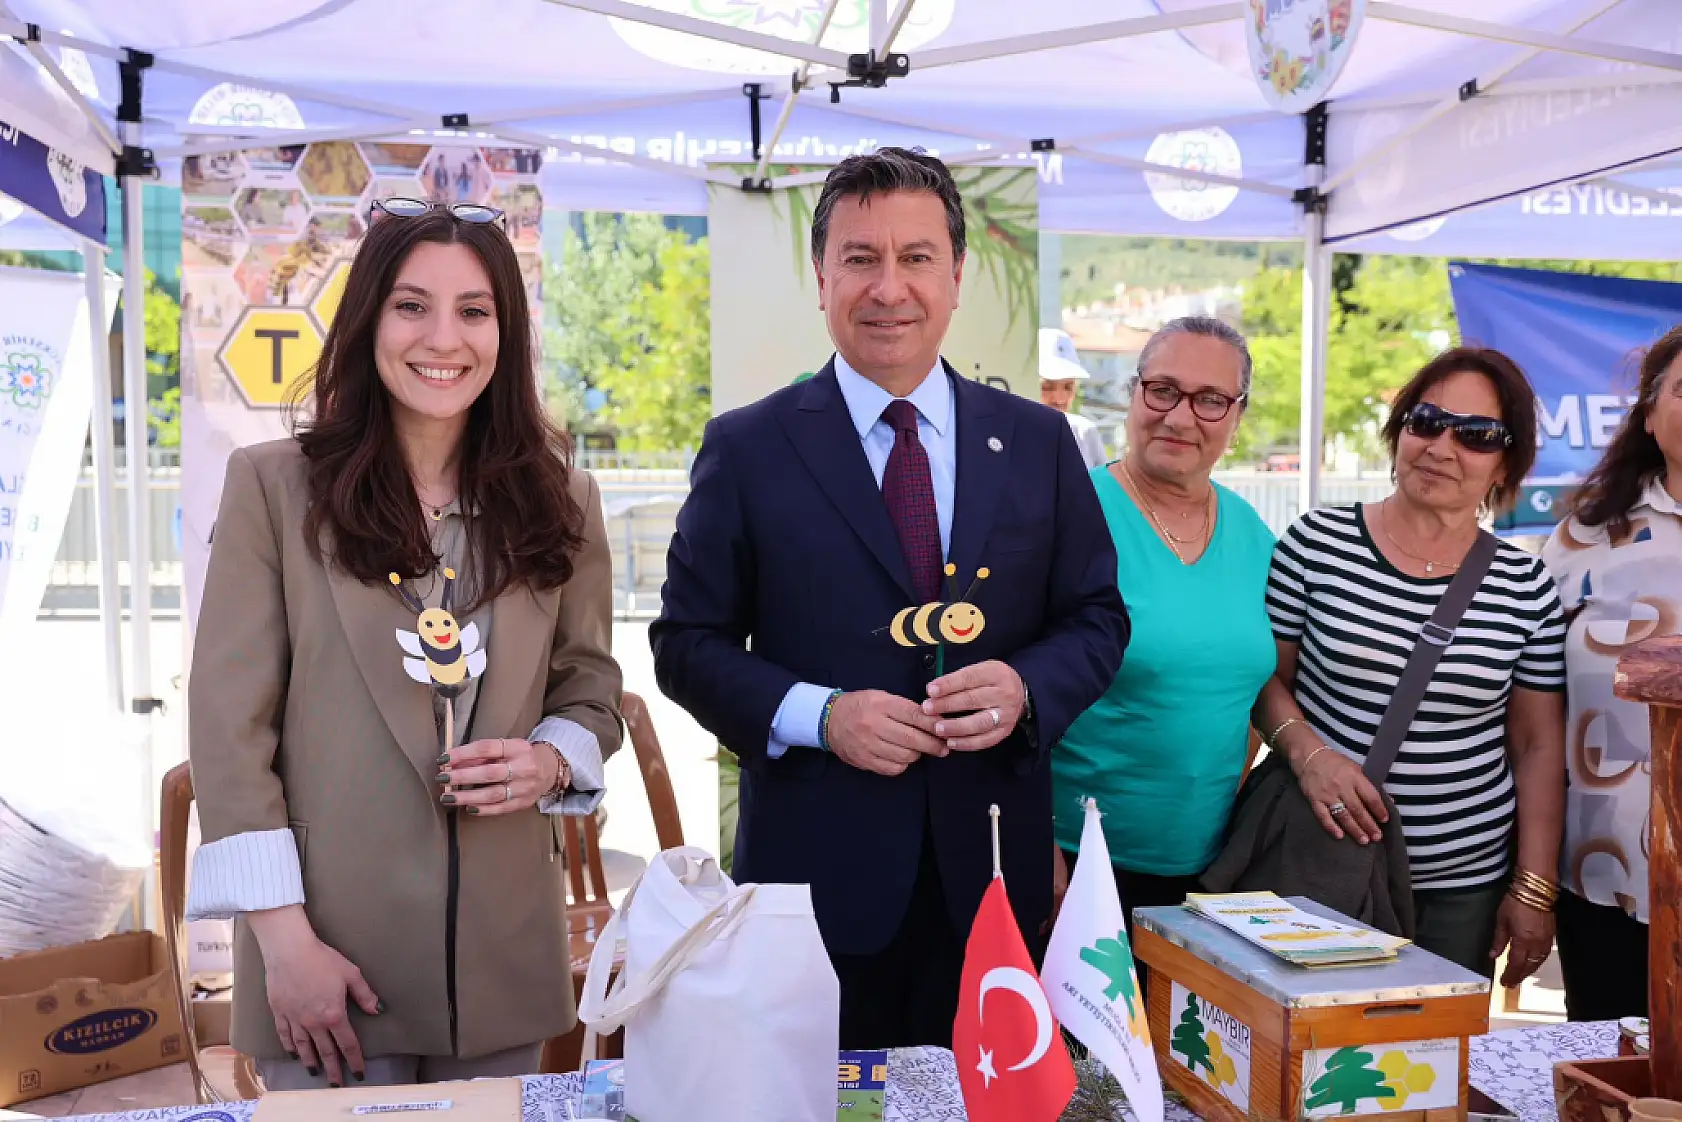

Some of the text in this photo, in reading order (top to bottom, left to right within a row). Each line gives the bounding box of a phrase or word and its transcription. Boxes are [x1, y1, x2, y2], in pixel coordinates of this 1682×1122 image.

[254, 328, 300, 384] T
[1534, 395, 1637, 446] ME
[63, 1014, 142, 1041] KIZILCIK
